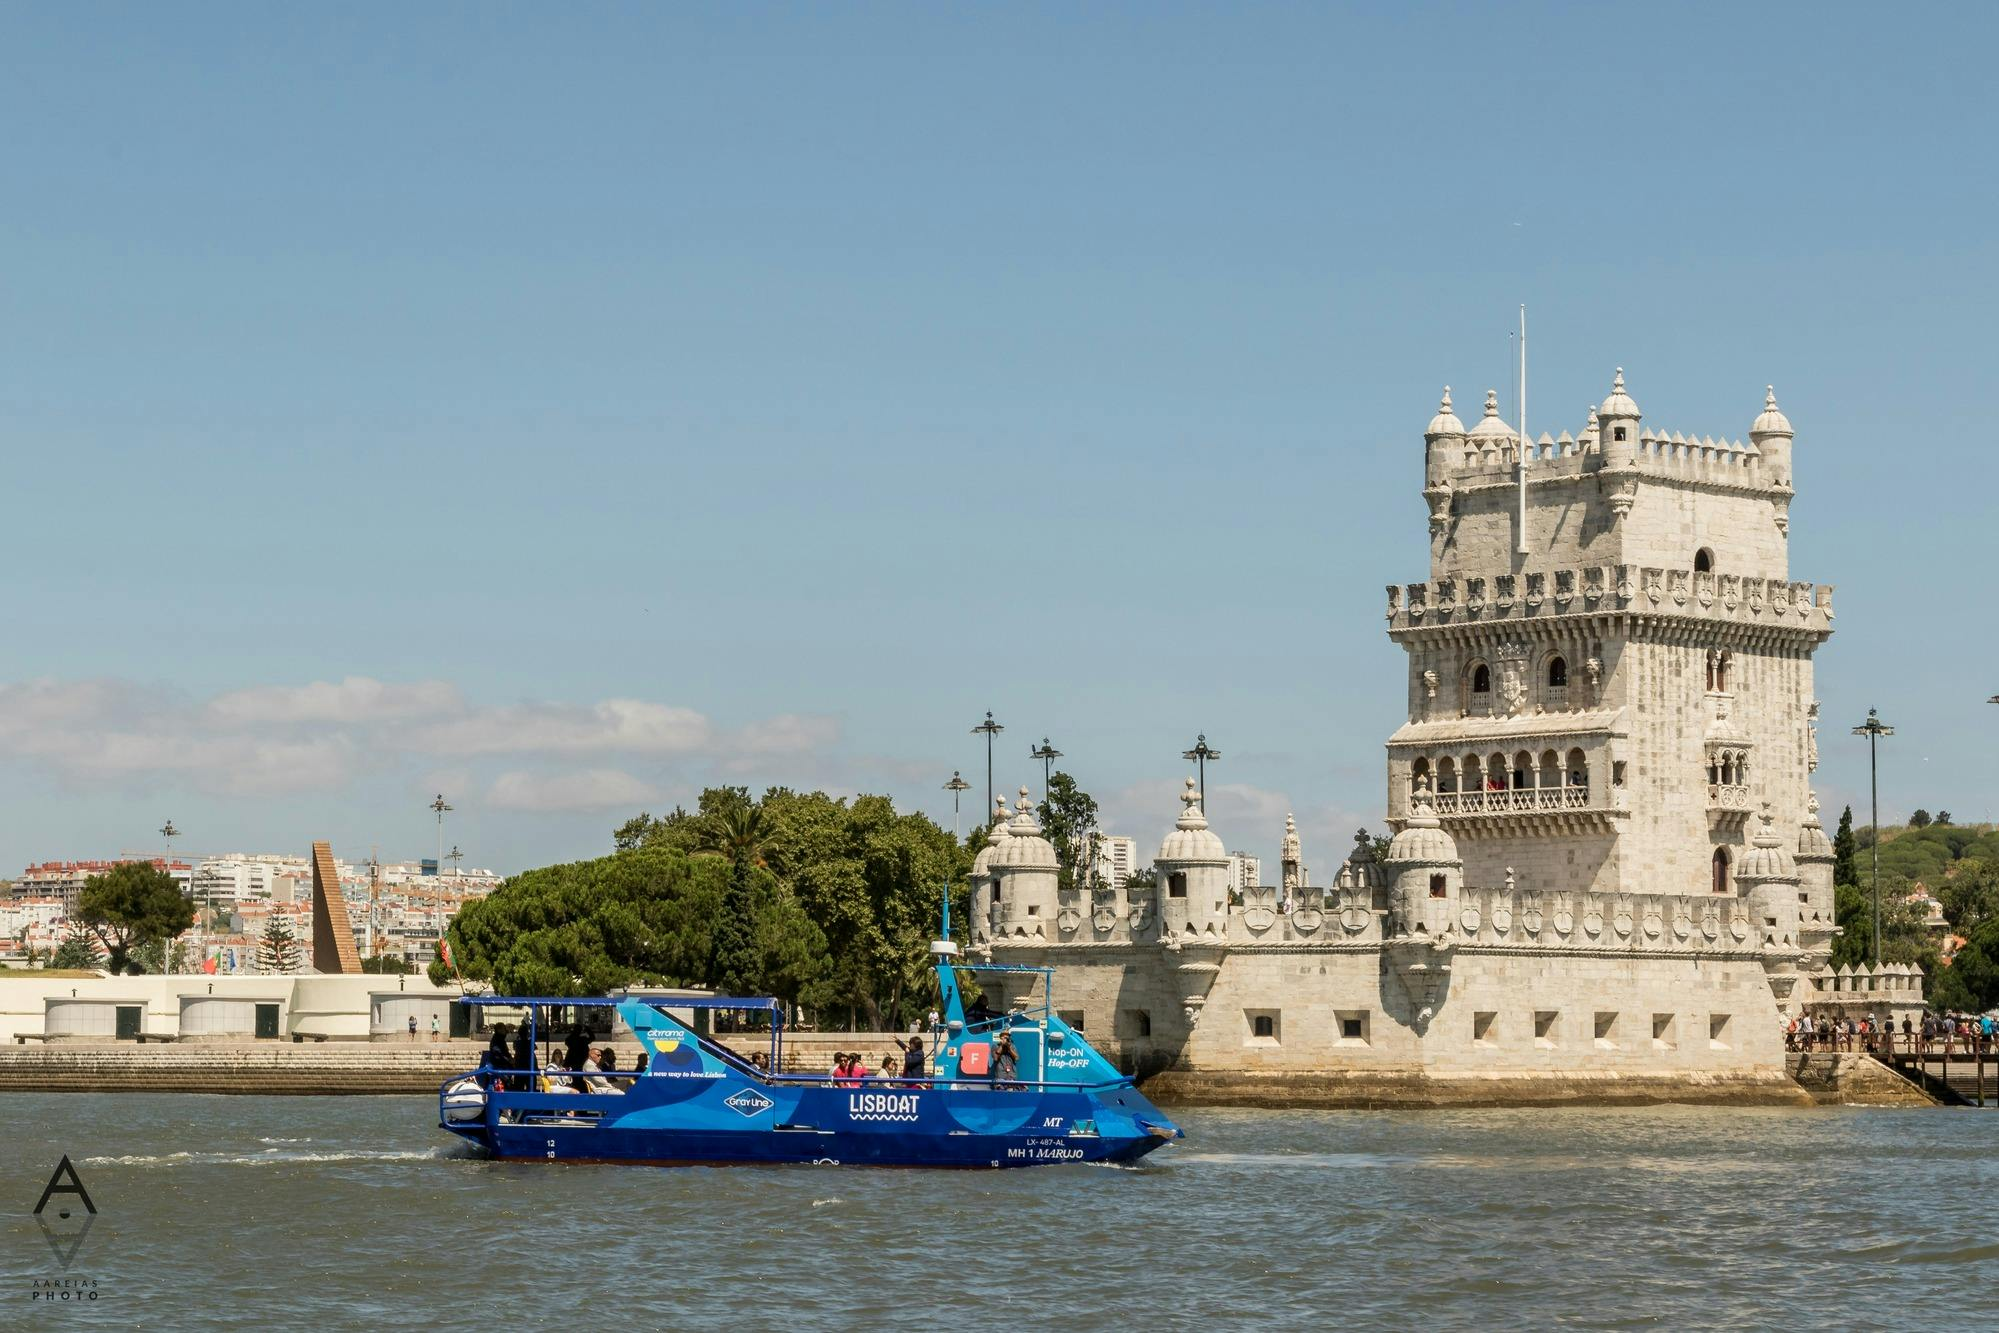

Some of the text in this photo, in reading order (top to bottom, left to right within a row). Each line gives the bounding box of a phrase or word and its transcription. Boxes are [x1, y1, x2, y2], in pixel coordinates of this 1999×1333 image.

[1048, 1047, 1084, 1058] Hop-ON
[971, 1053, 979, 1065] F
[1047, 1058, 1090, 1069] Hop-OFF
[850, 1093, 920, 1113] LISBOAT
[1042, 1117, 1064, 1128] MT
[546, 1139, 555, 1147] 12
[546, 1150, 555, 1159] 10
[1008, 1148, 1084, 1159] MH 1 MARUJO
[990, 1160, 999, 1168] 10
